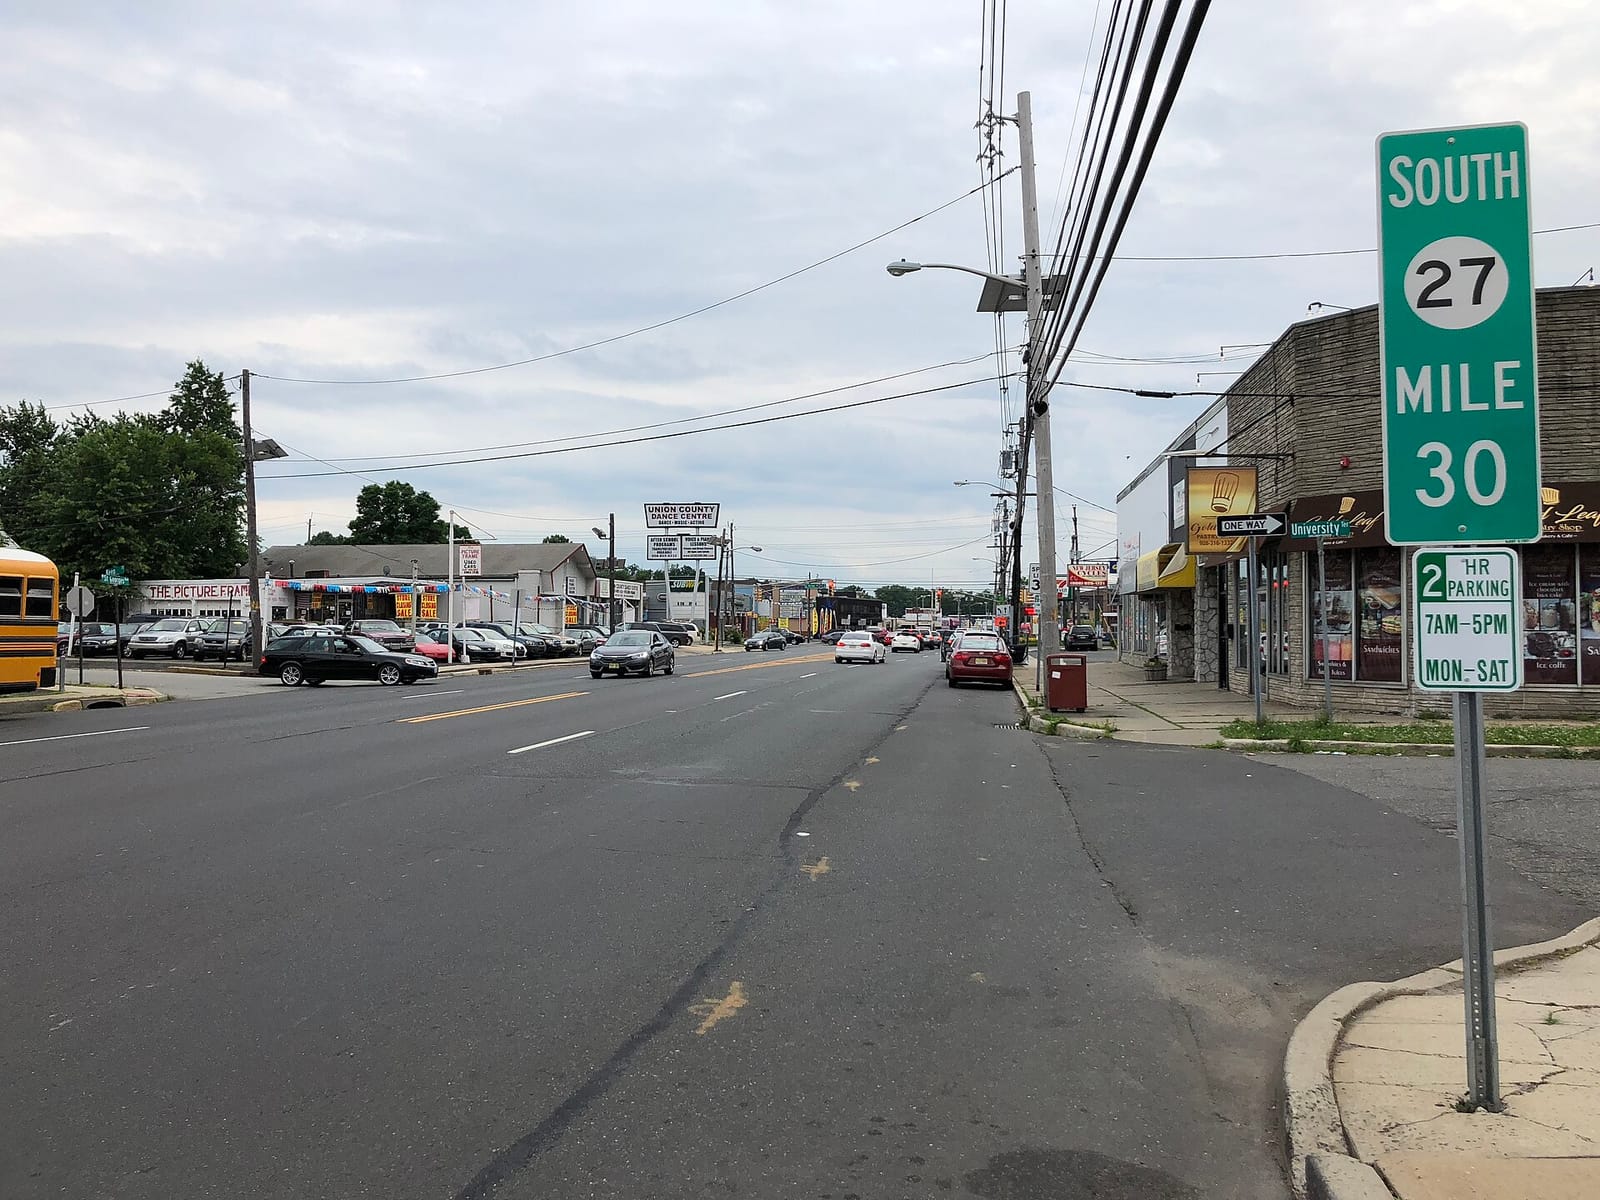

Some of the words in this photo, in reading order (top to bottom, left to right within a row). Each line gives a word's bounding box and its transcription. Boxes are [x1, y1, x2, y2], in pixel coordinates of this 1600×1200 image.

[1388, 151, 1520, 208] SOUTH
[1416, 257, 1496, 308] 27
[1395, 360, 1524, 414] MILE
[1415, 440, 1508, 508] 30
[1224, 521, 1244, 530] ONE
[1246, 520, 1266, 530] WAY
[1291, 521, 1340, 536] University
[1558, 523, 1583, 532] Shop
[1465, 559, 1490, 575] HR
[1422, 564, 1443, 597] 2
[149, 586, 171, 598] THE
[173, 586, 217, 598] PICTURE
[1448, 580, 1509, 597] PARKING
[397, 609, 412, 617] SALE
[421, 609, 436, 617] SALE
[1363, 644, 1400, 655] Sandwiches
